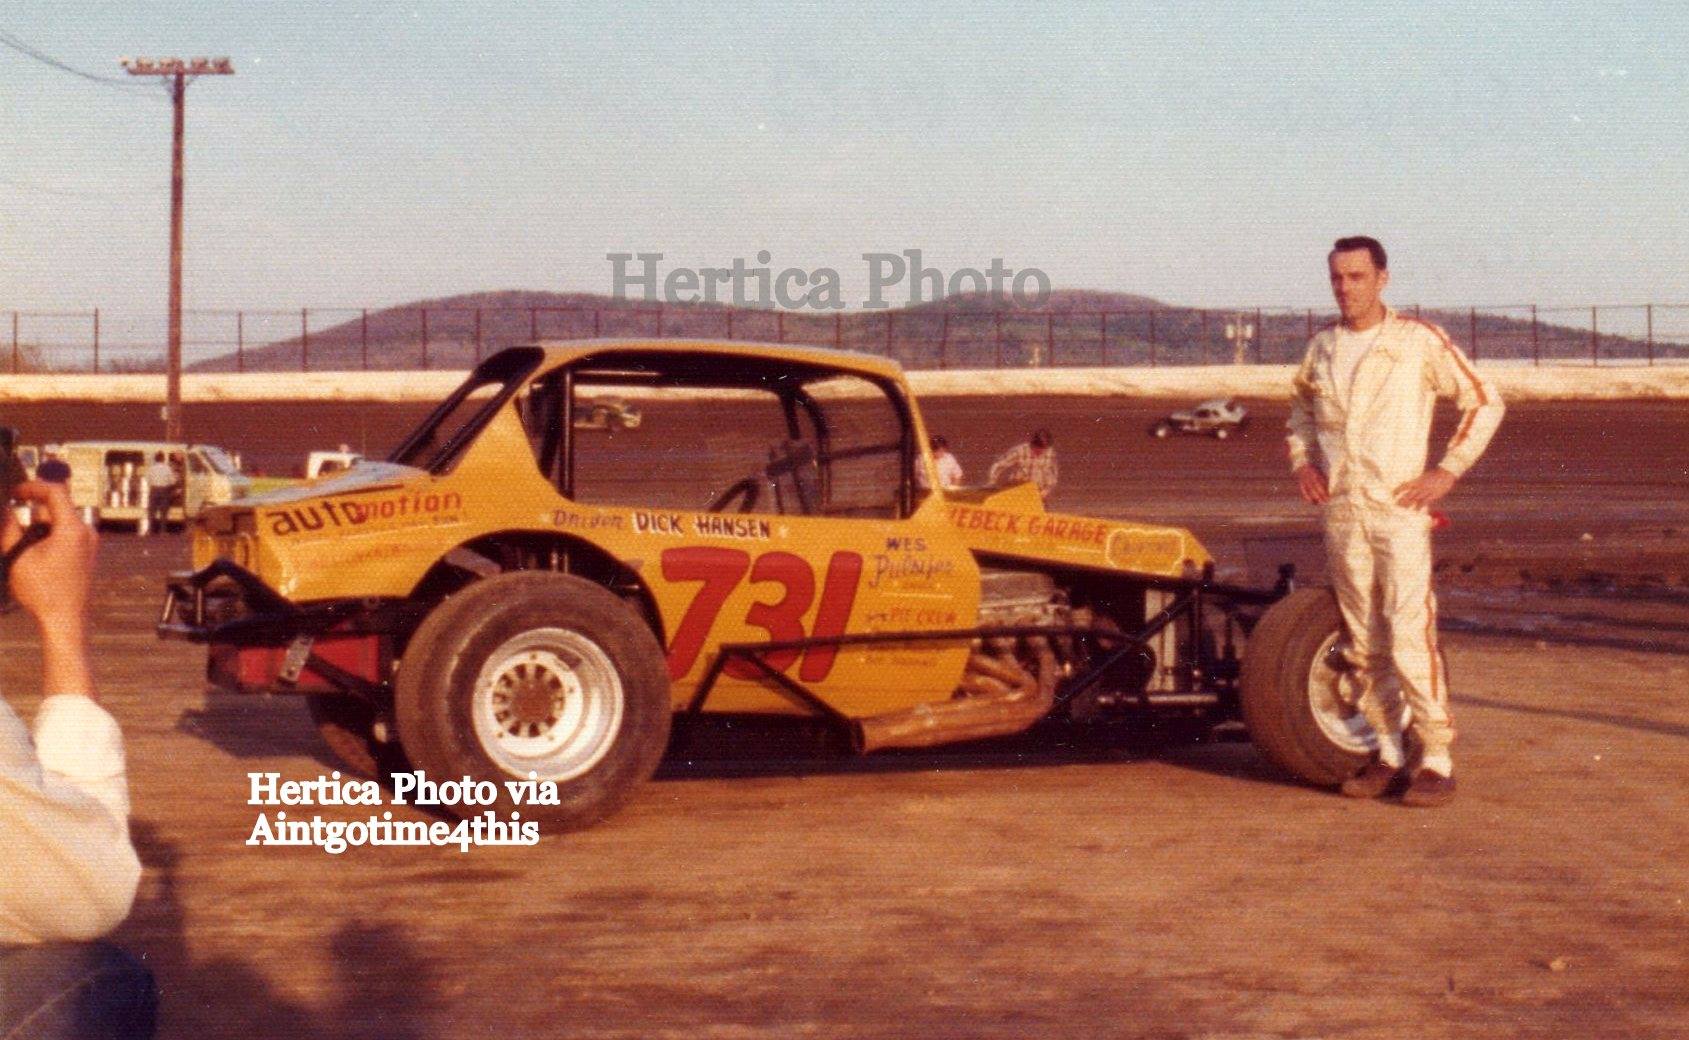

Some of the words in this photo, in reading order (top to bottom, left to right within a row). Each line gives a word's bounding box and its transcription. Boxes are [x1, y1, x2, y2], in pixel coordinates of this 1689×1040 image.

[633, 511, 683, 534] DICK
[694, 514, 772, 540] HANSEN
[1028, 516, 1107, 544] GARAGE
[661, 546, 864, 684] 731
